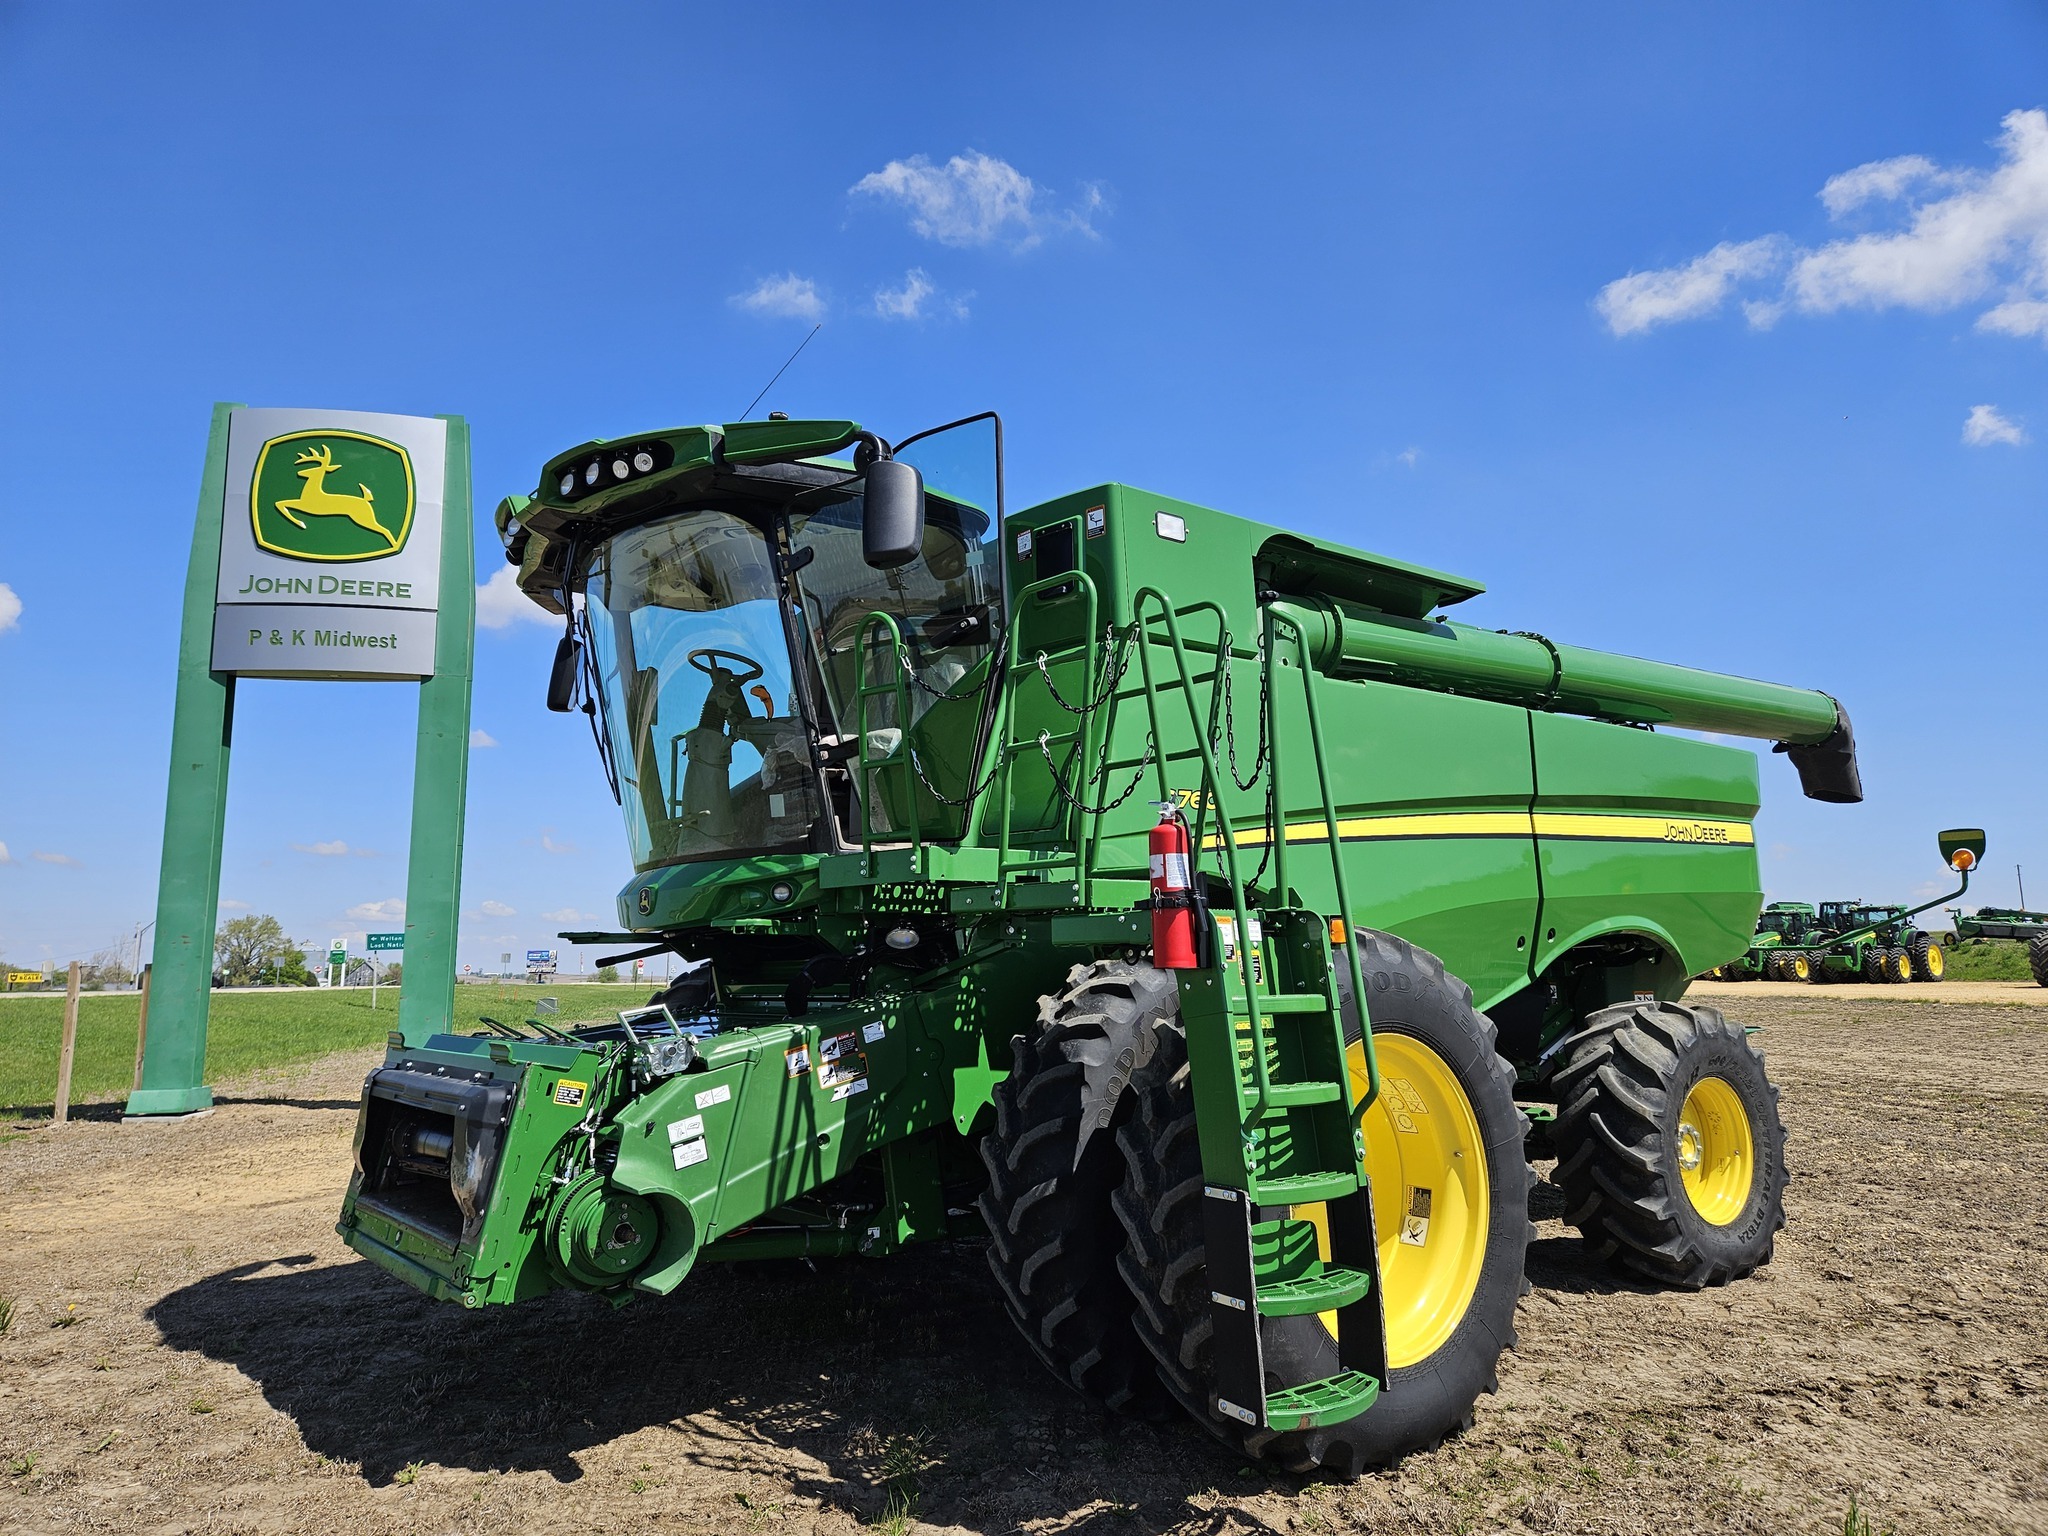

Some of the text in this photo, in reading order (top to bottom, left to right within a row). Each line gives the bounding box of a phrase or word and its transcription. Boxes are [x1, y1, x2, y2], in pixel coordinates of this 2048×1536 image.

[239, 575, 412, 599] JOHN DEERE
[248, 629, 397, 649] P & K Midwest
[1664, 822, 1728, 841] JOHN DEERE
[1738, 1100, 1773, 1244] OPTITRAC DT824
